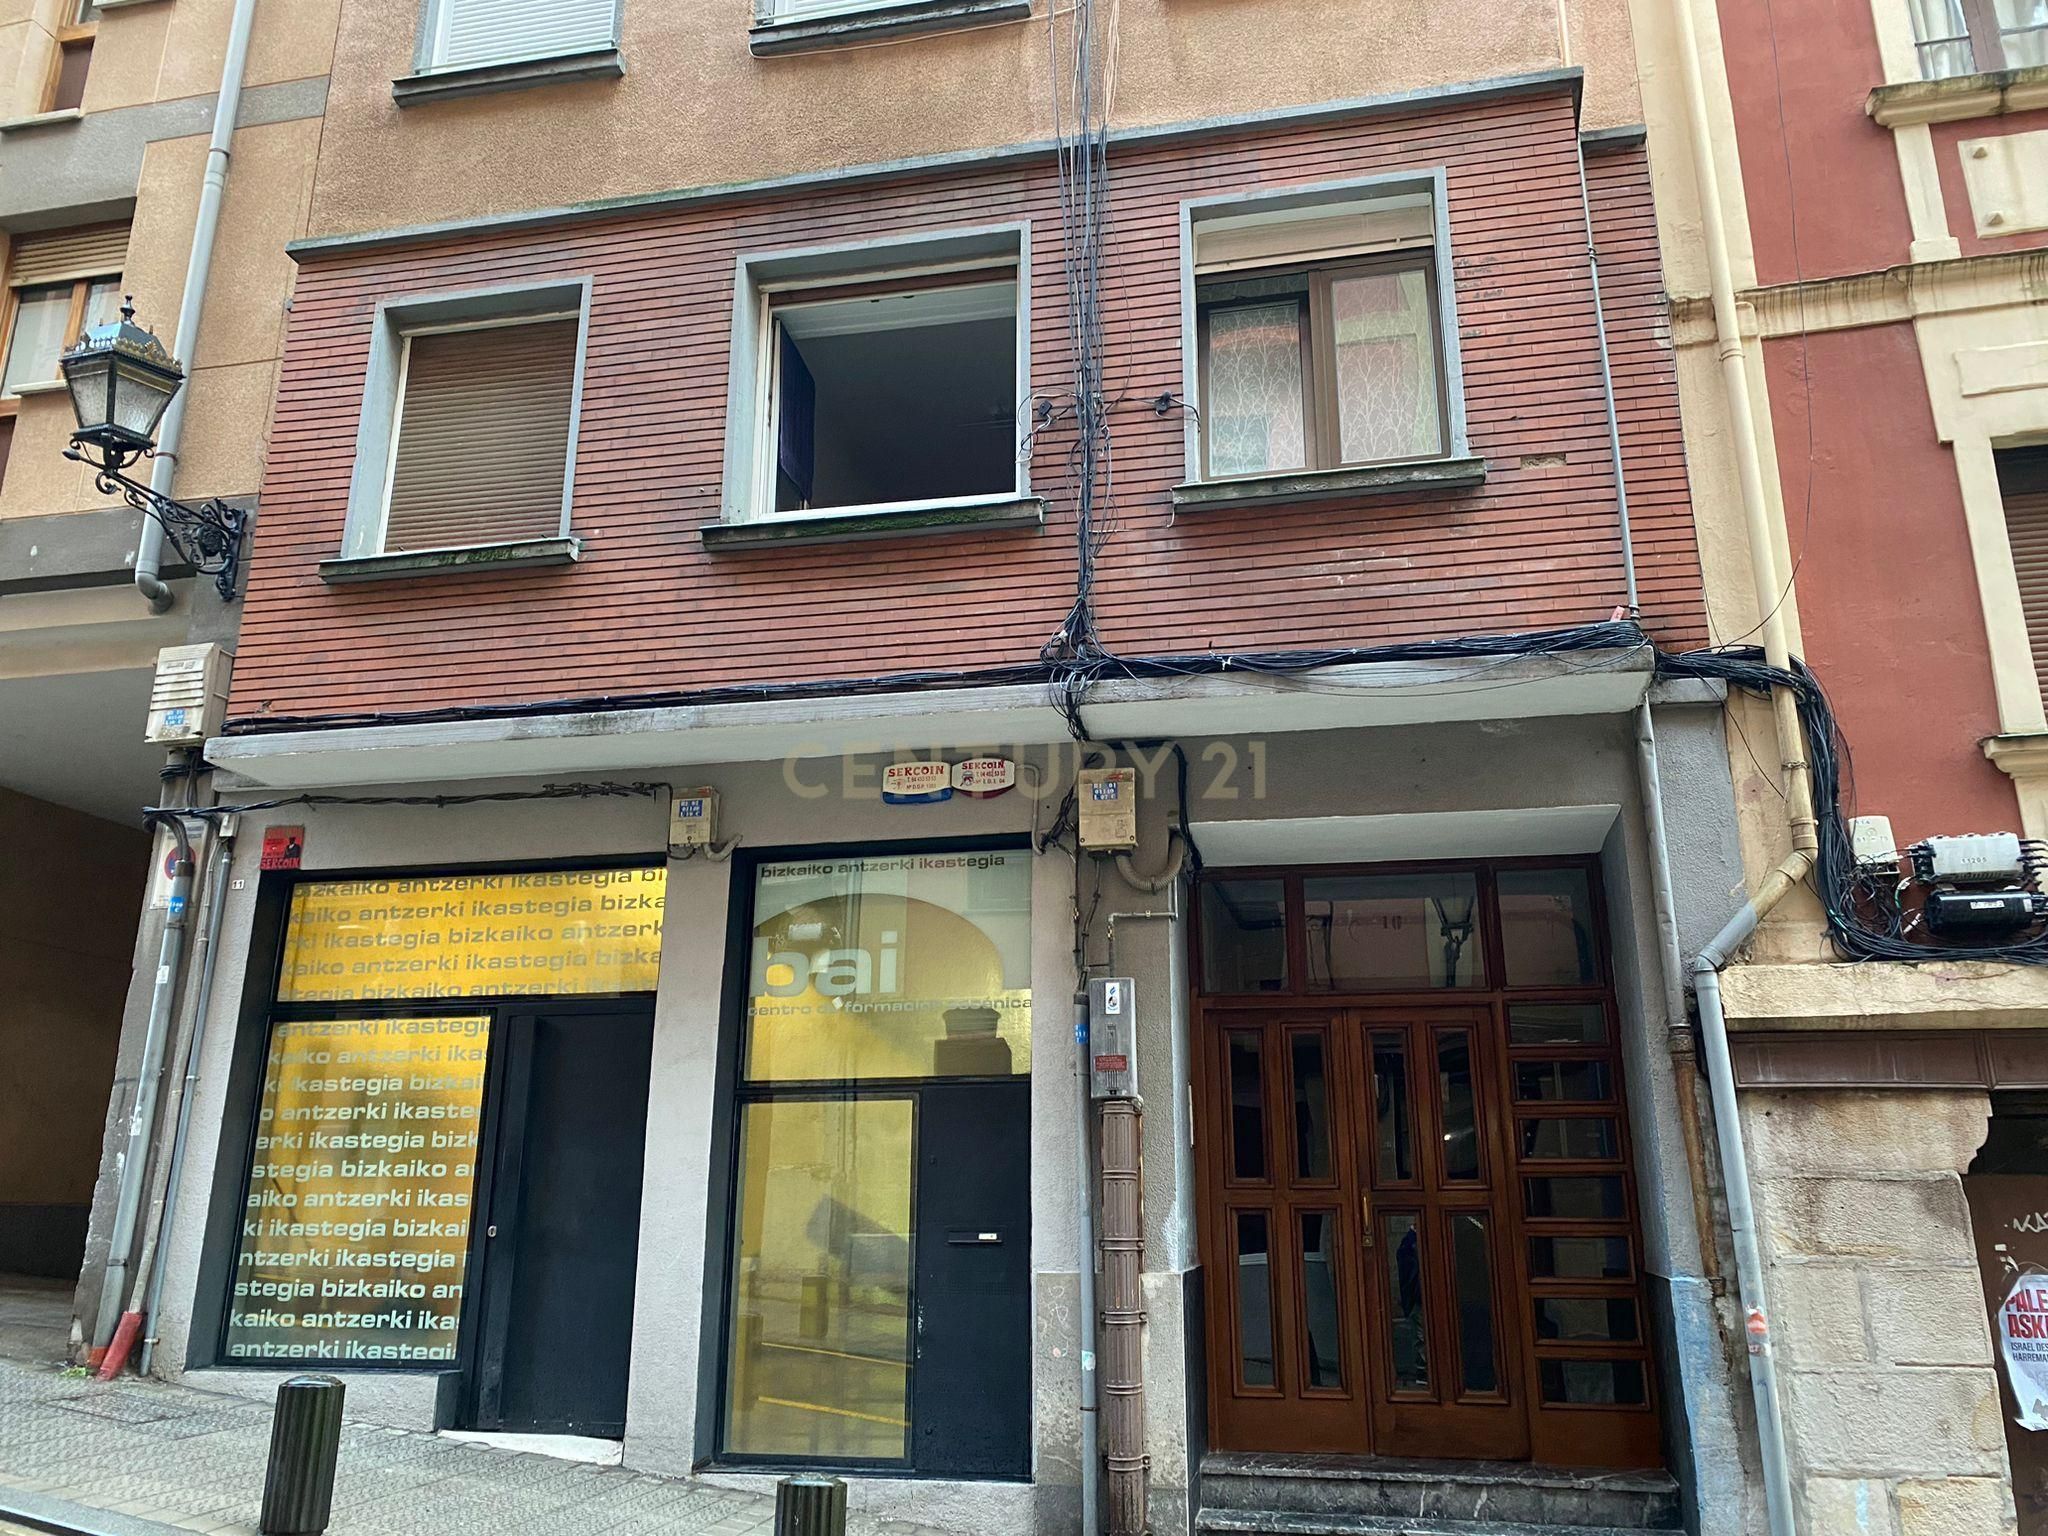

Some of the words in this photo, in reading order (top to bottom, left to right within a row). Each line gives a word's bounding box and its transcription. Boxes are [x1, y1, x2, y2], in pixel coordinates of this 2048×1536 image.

[888, 766, 944, 777] SERCOIN
[961, 761, 1006, 770] SERCOIN
[761, 864, 834, 878] bizkaiko
[837, 859, 914, 874] antzerki
[919, 855, 1005, 870] ikastegia
[359, 902, 464, 921] antzerki
[472, 896, 592, 917] ikastegia
[324, 929, 440, 950] ikastegia
[449, 925, 553, 945] bizkaiko
[352, 954, 458, 974] antzerki
[466, 950, 587, 971] ikastegia
[749, 930, 898, 997] bai
[277, 1019, 379, 1037] antzerki
[337, 1046, 440, 1064] antzerki
[281, 1102, 387, 1121] antzerki
[255, 1131, 302, 1150] erki
[309, 1130, 424, 1153] ikastegia
[251, 1160, 334, 1182] stegia
[341, 1159, 447, 1178] bizkaiko
[247, 1189, 298, 1207] aiko
[304, 1189, 411, 1208] antzerki
[243, 1219, 264, 1237] ki
[268, 1219, 386, 1242] ikastegia
[392, 1218, 467, 1238] bizkai
[336, 1249, 456, 1272] ikastegia
[234, 1279, 315, 1302] stegia
[321, 1278, 426, 1299] bizkaiko
[230, 1308, 296, 1328] kaiko
[301, 1310, 412, 1329] antzerki
[417, 1311, 458, 1329] ika
[231, 1340, 339, 1358] antzerki
[345, 1341, 456, 1361] ikastegi
[2011, 1342, 2035, 1351] ISRAEL
